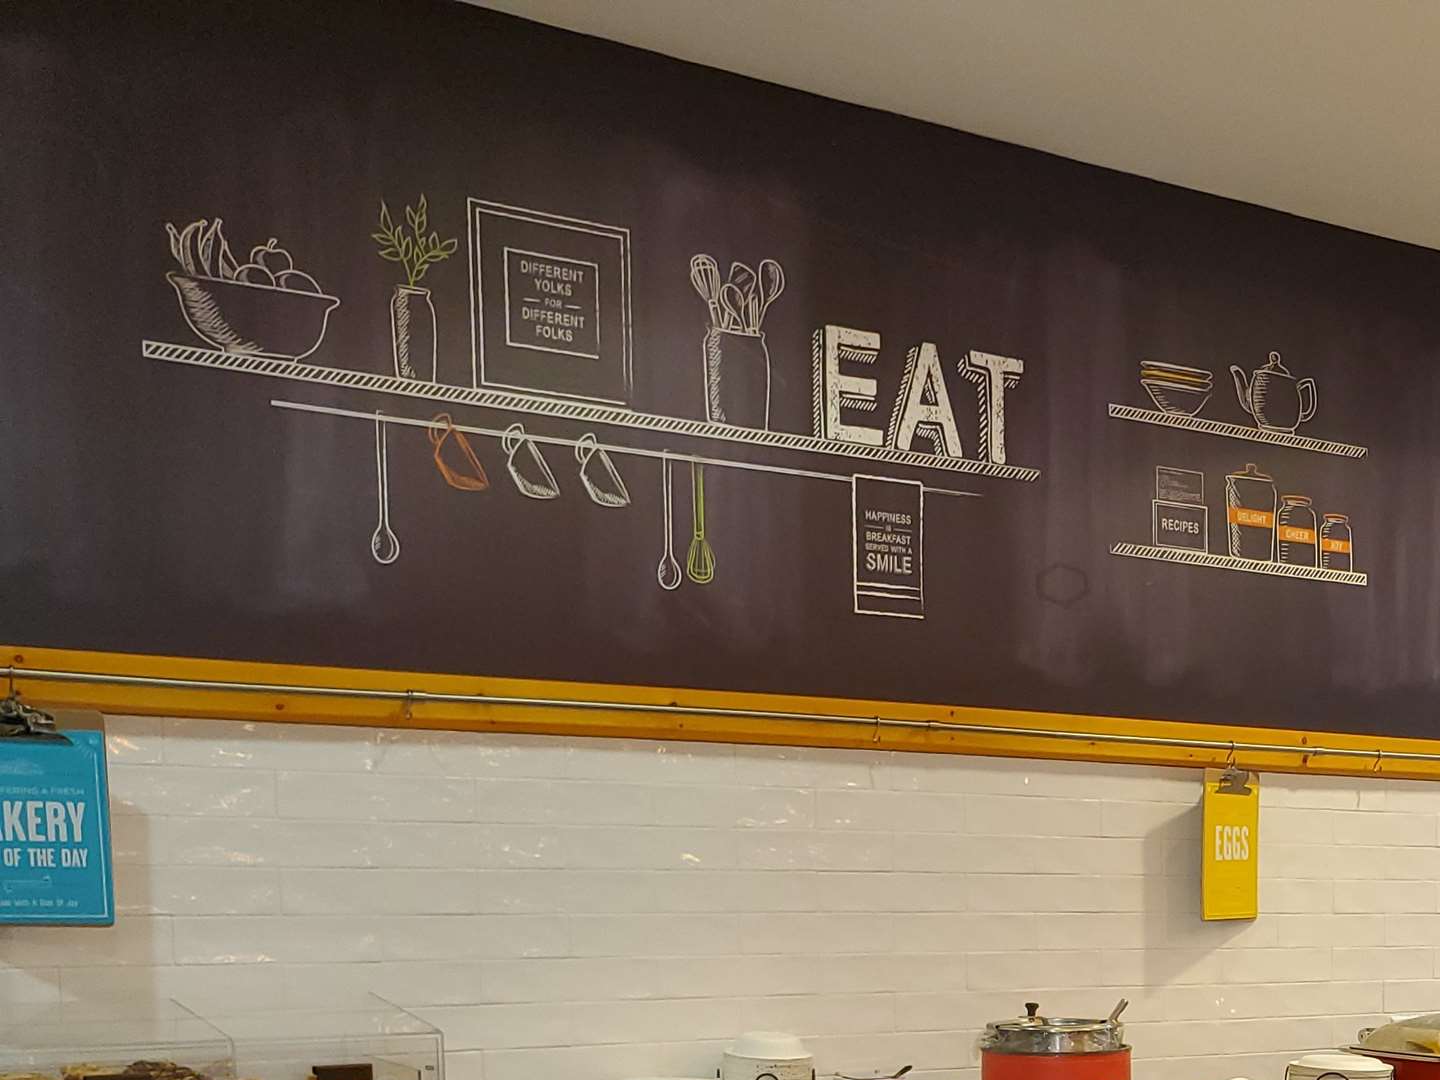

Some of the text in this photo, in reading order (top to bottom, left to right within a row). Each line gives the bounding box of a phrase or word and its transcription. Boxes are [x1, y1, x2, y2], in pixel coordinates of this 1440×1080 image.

[521, 260, 584, 283] DIFFERENT
[534, 278, 572, 296] YOLKS
[544, 298, 562, 308] FOR
[522, 307, 585, 328] DIFFERENT
[536, 325, 573, 342] FOLKS
[812, 324, 1024, 465] EAT
[865, 510, 912, 525] HAPPINESS
[1236, 510, 1268, 525] DELIGHT
[1161, 518, 1200, 535] RECIPES
[1285, 528, 1310, 541] CHEER
[865, 531, 911, 545] BREAKFAST
[890, 546, 906, 554] WITH
[866, 553, 912, 575] SMILE
[0, 800, 85, 842] KERY
[1215, 825, 1249, 861] EGGS
[4, 848, 88, 868] OF THE DAY
